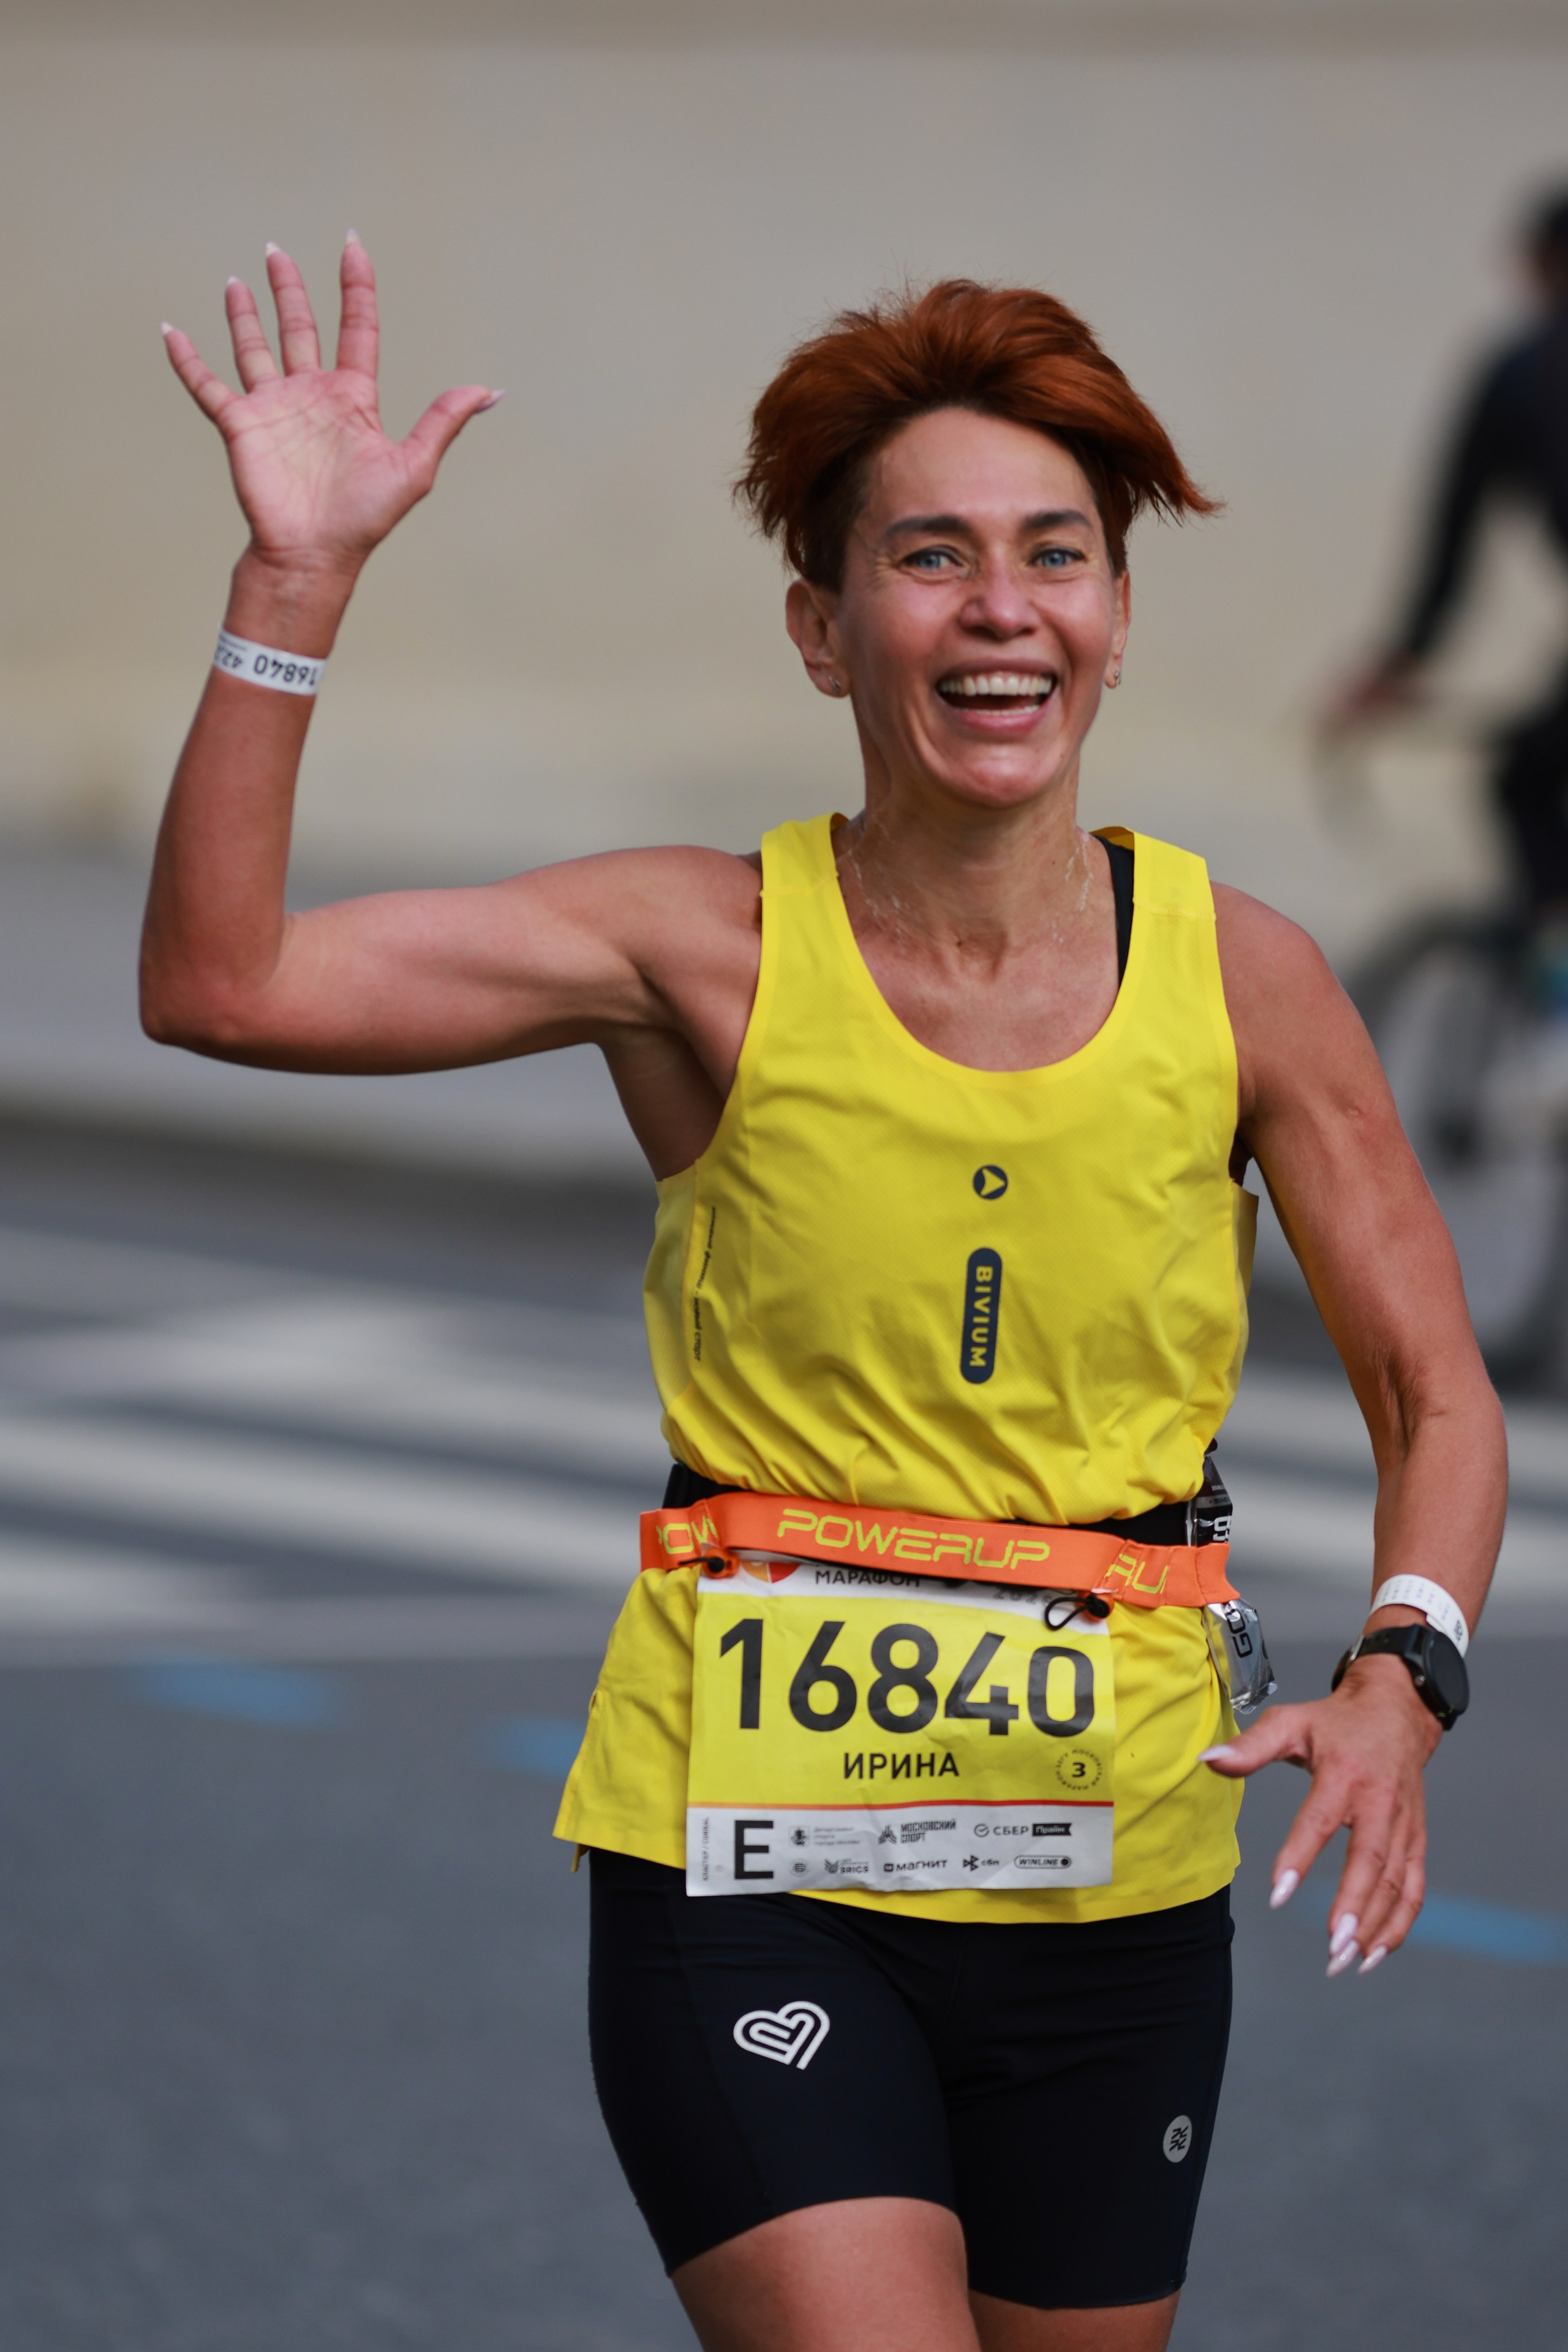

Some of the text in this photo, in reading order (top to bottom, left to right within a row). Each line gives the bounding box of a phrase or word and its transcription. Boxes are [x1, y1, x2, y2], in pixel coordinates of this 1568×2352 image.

[253, 654, 317, 686] 16840
[969, 1265, 994, 1367] BIVIUM
[777, 1508, 1050, 1569] POWERUP
[815, 1569, 921, 1588] МАРАФОН
[719, 1618, 1095, 1738] 16840
[843, 1752, 960, 1780] ИРИНА
[1071, 1761, 1087, 1778] 3
[900, 1818, 956, 1833] МОСКОВСКИЙ
[900, 1832, 926, 1844] СПОРТ
[993, 1826, 1029, 1836] СБЕР
[734, 1820, 774, 1879] E
